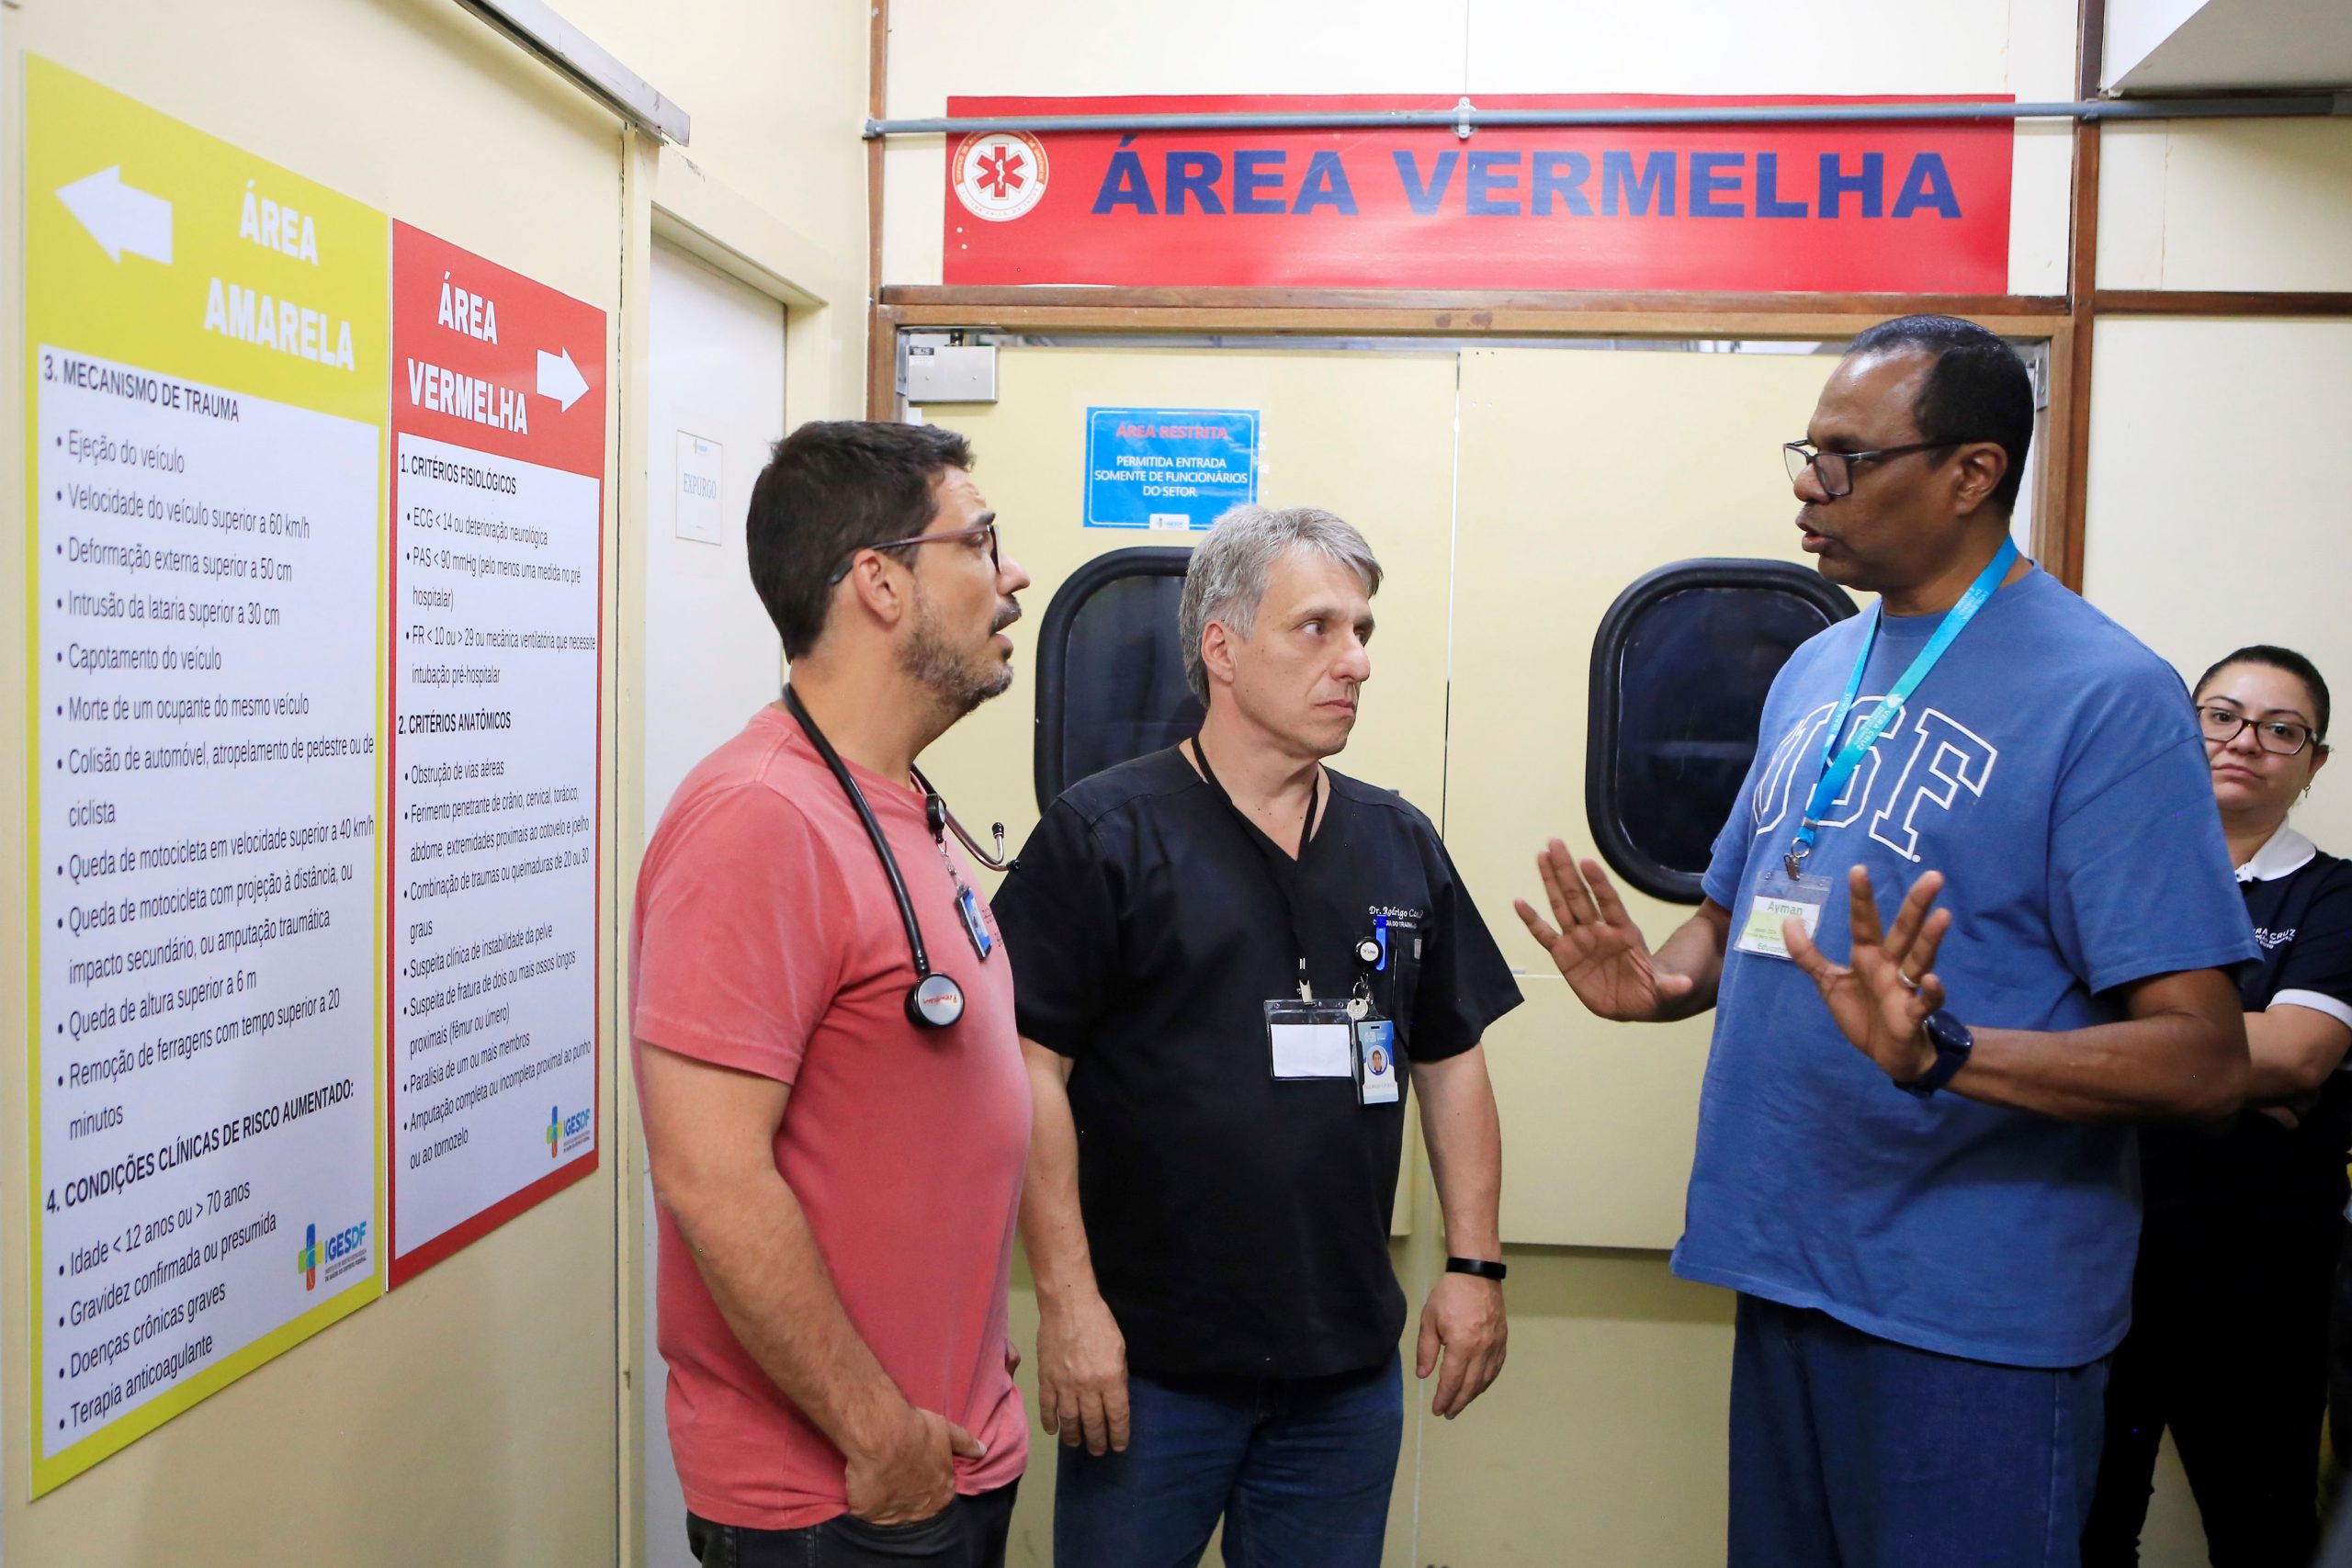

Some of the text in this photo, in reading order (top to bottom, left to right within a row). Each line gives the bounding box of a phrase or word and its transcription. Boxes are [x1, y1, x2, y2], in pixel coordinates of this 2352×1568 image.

[1091, 134, 1360, 216] ÁREA
[1392, 150, 1962, 220] VERMELHA
[239, 179, 319, 265] ÁREA
[204, 276, 355, 372] AMARELA
[437, 271, 498, 345] ÁREA
[43, 354, 239, 423] 3. MECANISMO DE TRAUMA
[407, 357, 528, 435] VERMELHA
[68, 428, 184, 473] Ejeção do veículo
[1116, 422, 1228, 439] ÁREA RESTRITA
[411, 455, 458, 483] CRITÉRIOS
[459, 465, 516, 495] FISIOLÓGICOS
[1095, 470, 1248, 483] SOMENTE DE FUNCIONÁRIOS
[1116, 456, 1227, 468] PERMITIDA ENTRADA
[684, 472, 717, 500] EXPURGO
[1143, 486, 1159, 496] DO
[67, 482, 310, 538] Velocidade do veículo superior a 60 km/h
[413, 506, 433, 528] ECG
[442, 511, 452, 532] 14
[453, 517, 463, 533] ou
[465, 514, 508, 544] deterioração
[509, 525, 548, 548] neurológica
[68, 536, 291, 581] Deformação externa superior a 50 cm
[68, 590, 279, 628] Intrusão da lataria superior a 30 cm
[413, 583, 454, 613] hospitalar)
[68, 642, 221, 675] Capotamento do veículo
[412, 662, 500, 689] intubação pré-hospitalar
[69, 691, 309, 725] Morte de um ocupante do mesmo veículo
[408, 708, 456, 734] CRITÉRIOS
[458, 705, 511, 732] ANATÔMICOS
[68, 732, 374, 774] Colisão de automóvel, atropelamento de pedestre ou de
[411, 757, 504, 786] Obstrução de vias aéreas
[68, 798, 116, 828] ciclista
[68, 814, 374, 885] Queda de motocicleta em velocidade superior a 40 km/h
[68, 861, 352, 938] Queda de motocicleta com projeção à distância, ou
[1382, 906, 1408, 919] Rodrigo
[1767, 899, 1804, 917] Ayman
[69, 906, 330, 988] impacto secundário, ou amputação traumática
[409, 919, 433, 945] graus
[410, 921, 552, 980] Suspeita clínica de instabilidade da pelve
[2269, 928, 2296, 940] CRUZ
[410, 1001, 509, 1061] proximais (fêmur ou úmero)
[410, 1032, 529, 1093] Paralisia de um ou mais membros
[69, 1104, 123, 1140] minutos
[45, 1077, 354, 1214] 4. CONDIÇÕES CLÍNICAS DE RISCO AUMENTADO:
[410, 1126, 469, 1169] ou ao tornozelo
[324, 1221, 368, 1264] IGESDF
[69, 1210, 277, 1326] Gravidez confirmada ou presumida
[70, 1281, 225, 1379] Doenças crônicas graves
[70, 1334, 212, 1427] Terapia anticoagulante
